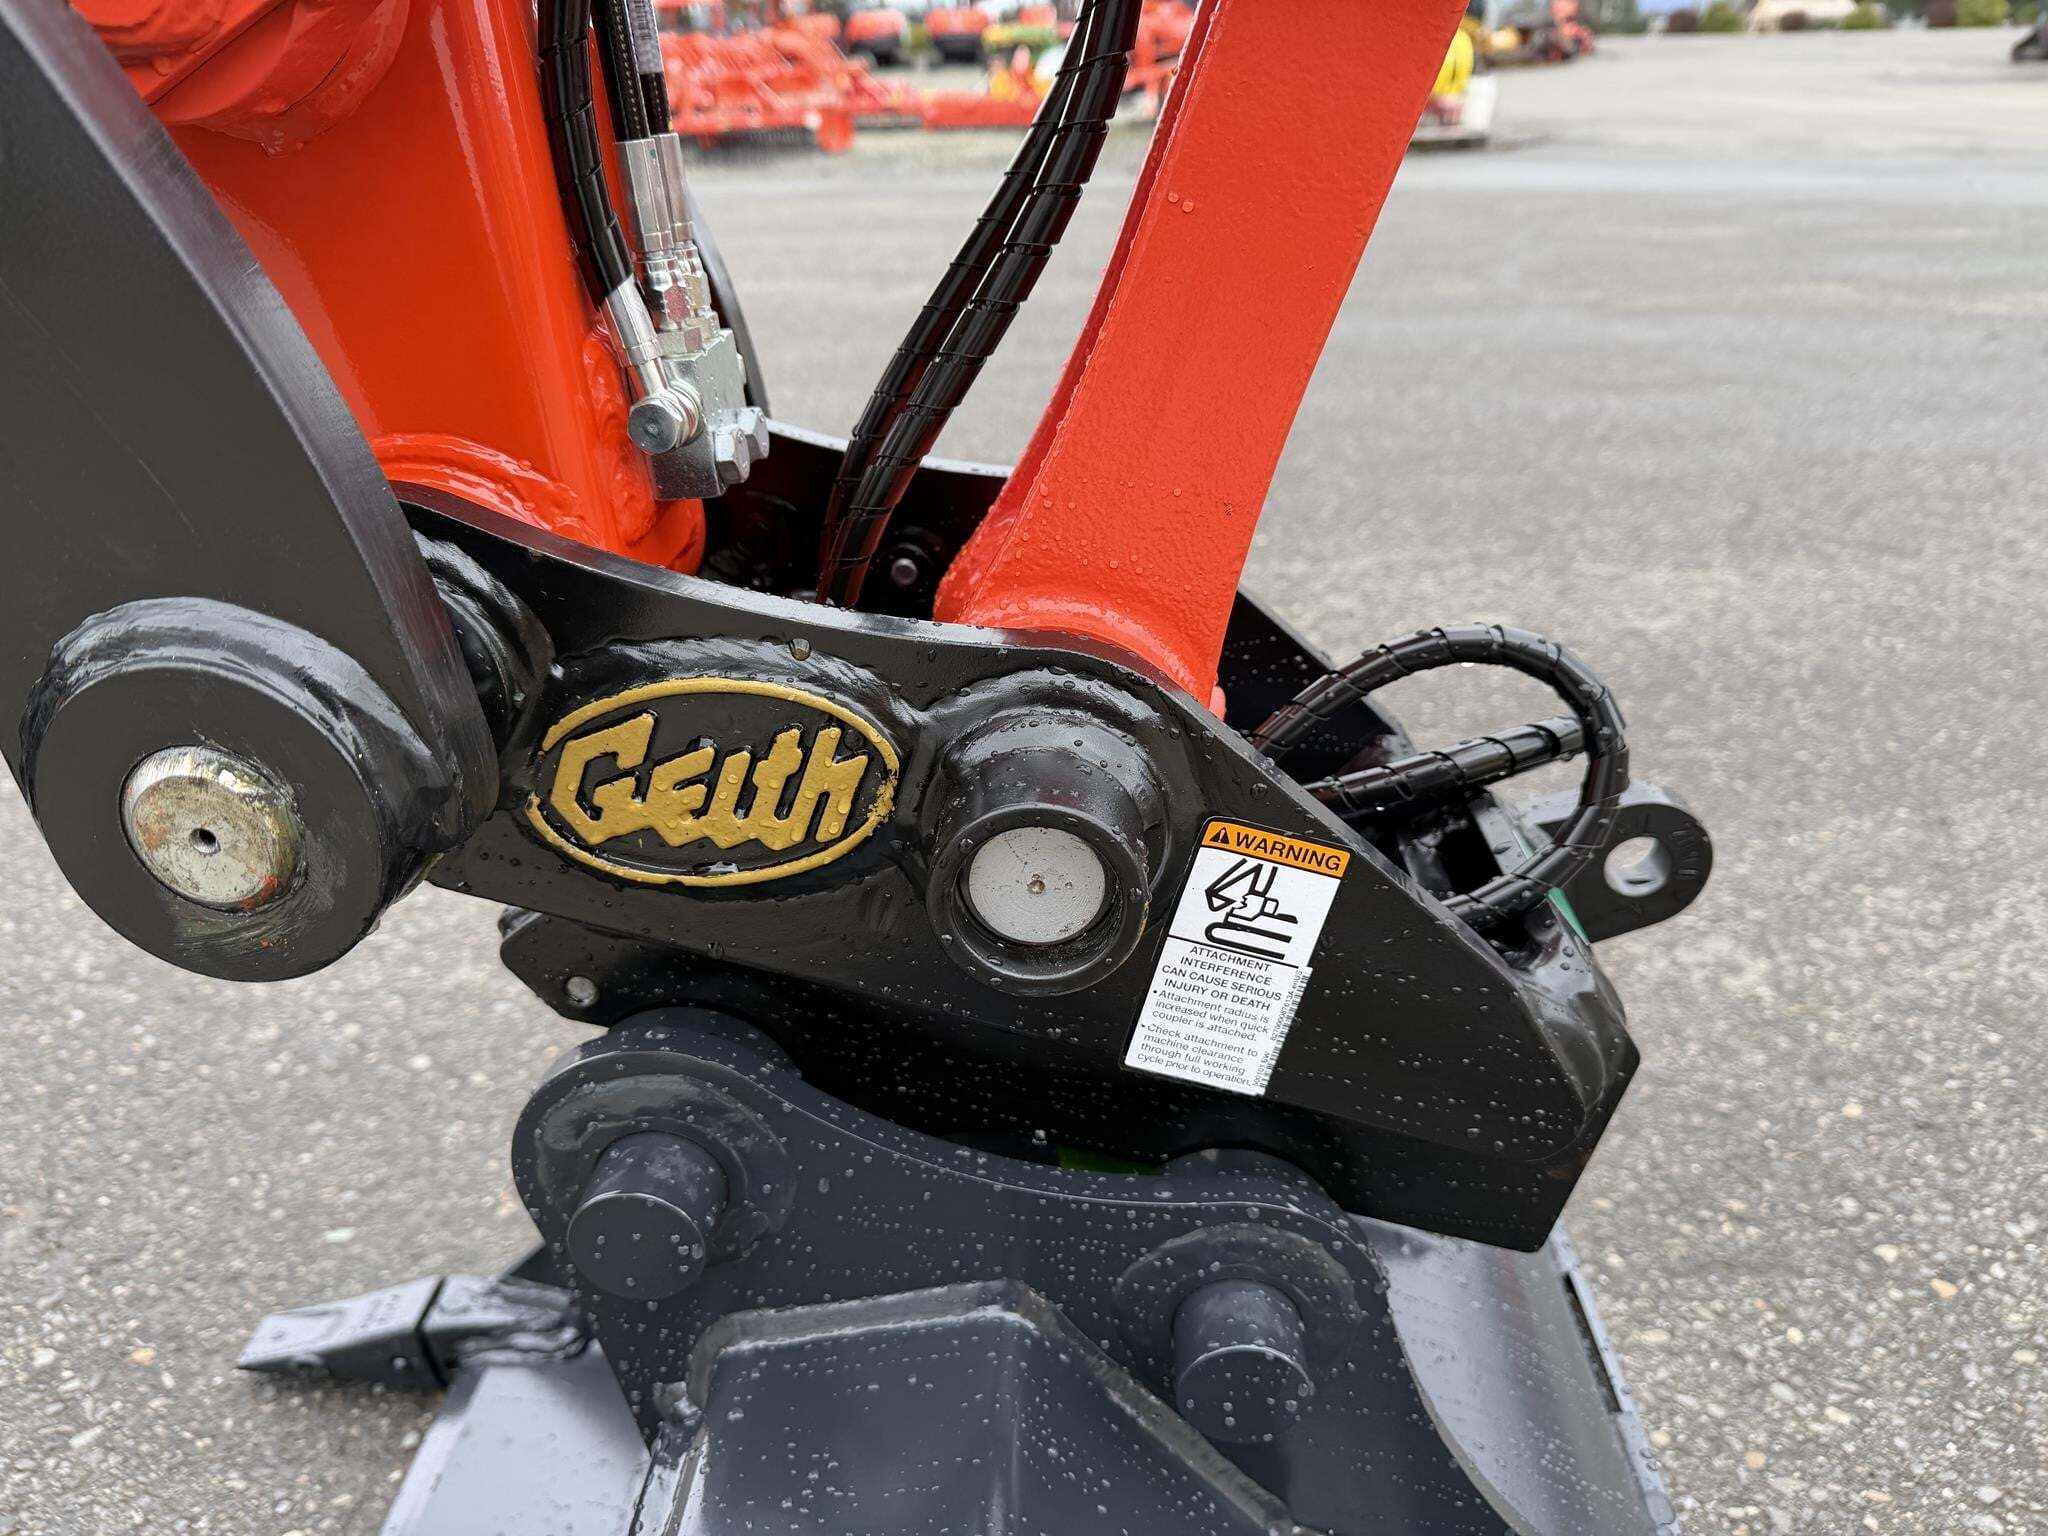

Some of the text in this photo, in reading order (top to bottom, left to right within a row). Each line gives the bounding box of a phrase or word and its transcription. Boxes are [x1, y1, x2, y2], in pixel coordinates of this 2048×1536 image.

[550, 712, 868, 851] Geith
[1235, 831, 1342, 872] WARNING
[1180, 956, 1272, 986] INTERFERENCE
[1190, 946, 1271, 972] ATTACHMENT
[1162, 964, 1282, 1001] CAN CAUSE SERIOUS
[1164, 978, 1271, 1011] INJURY OR DEATH
[1155, 1000, 1270, 1035] increased when quick
[1158, 989, 1270, 1024] Attachment radius is
[1147, 1023, 1258, 1057] Check attachment to
[1152, 1010, 1257, 1042] coupler is attached.
[1141, 1043, 1246, 1077] through full working
[1143, 1034, 1244, 1064] machine clearance
[1137, 1053, 1252, 1087] cycle prior to operation.
